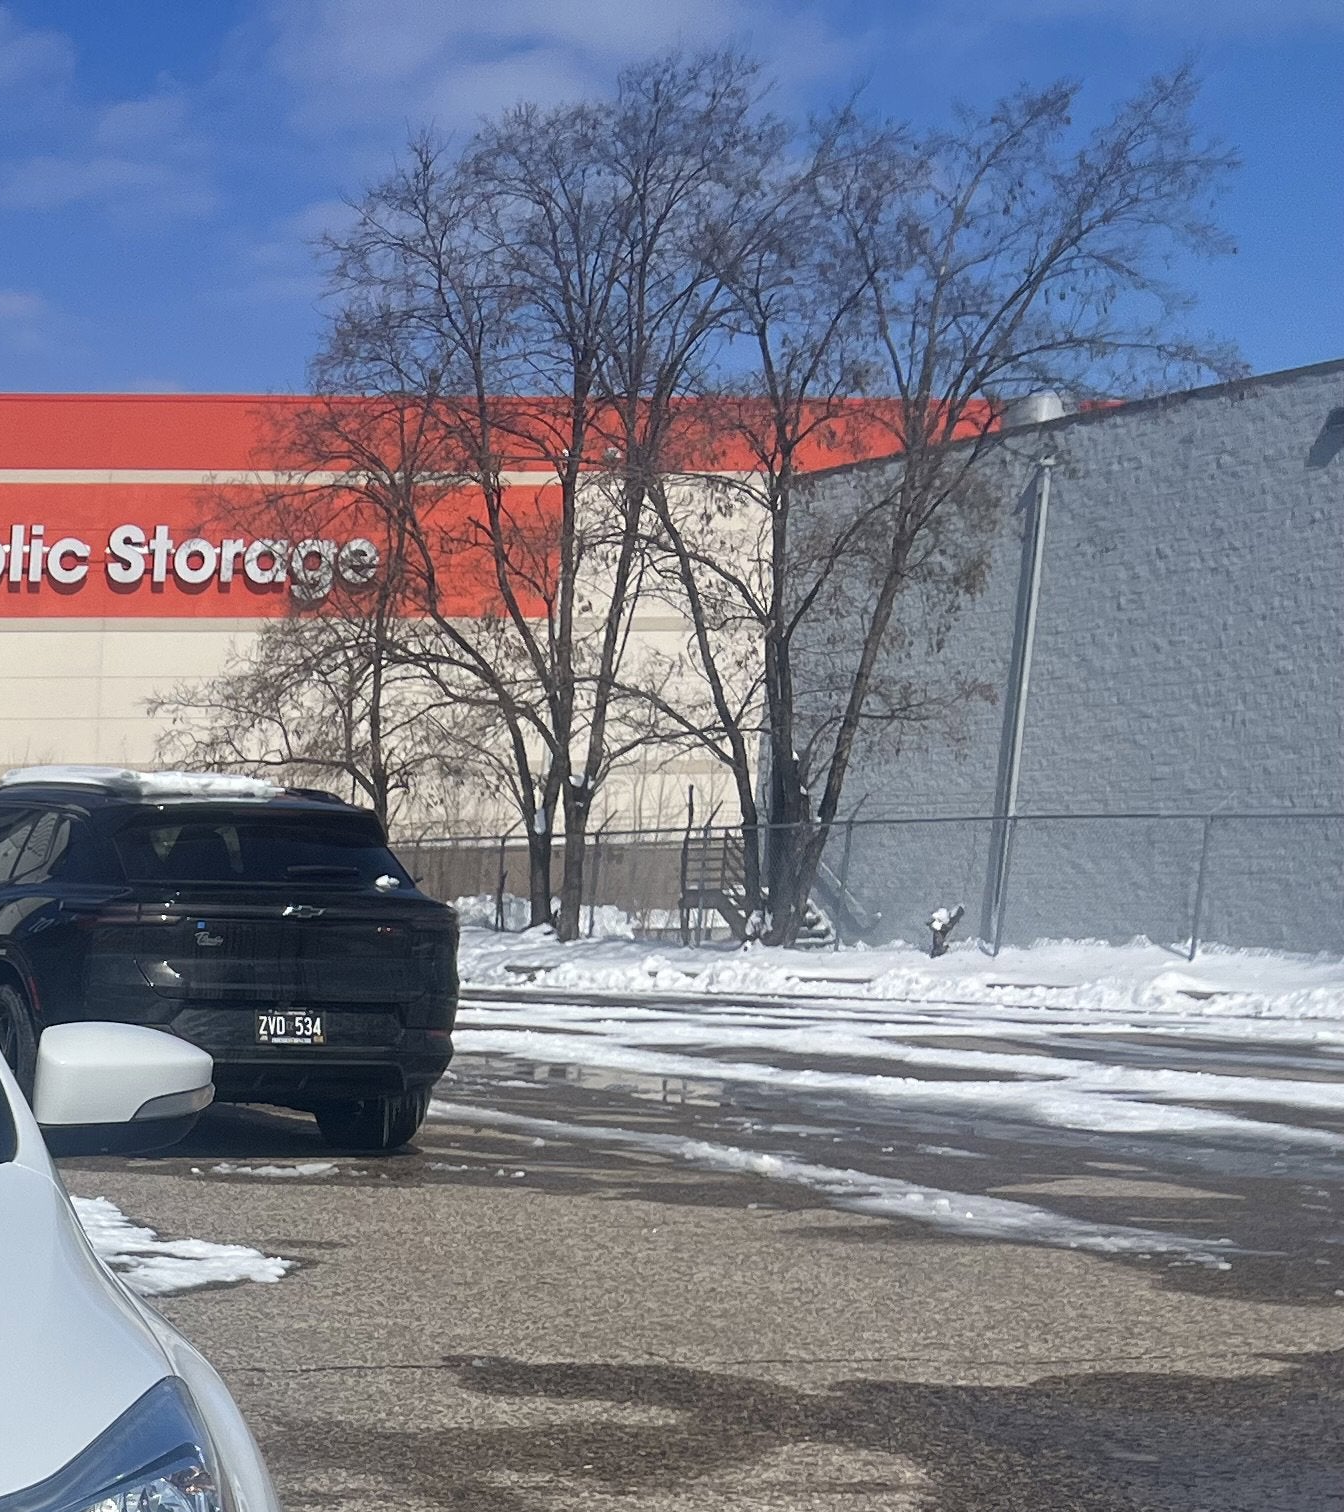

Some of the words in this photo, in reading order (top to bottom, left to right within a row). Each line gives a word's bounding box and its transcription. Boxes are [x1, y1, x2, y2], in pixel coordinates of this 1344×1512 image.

[107, 523, 382, 600] Storage
[258, 1015, 286, 1036] ZVD
[294, 1015, 322, 1036] 534
